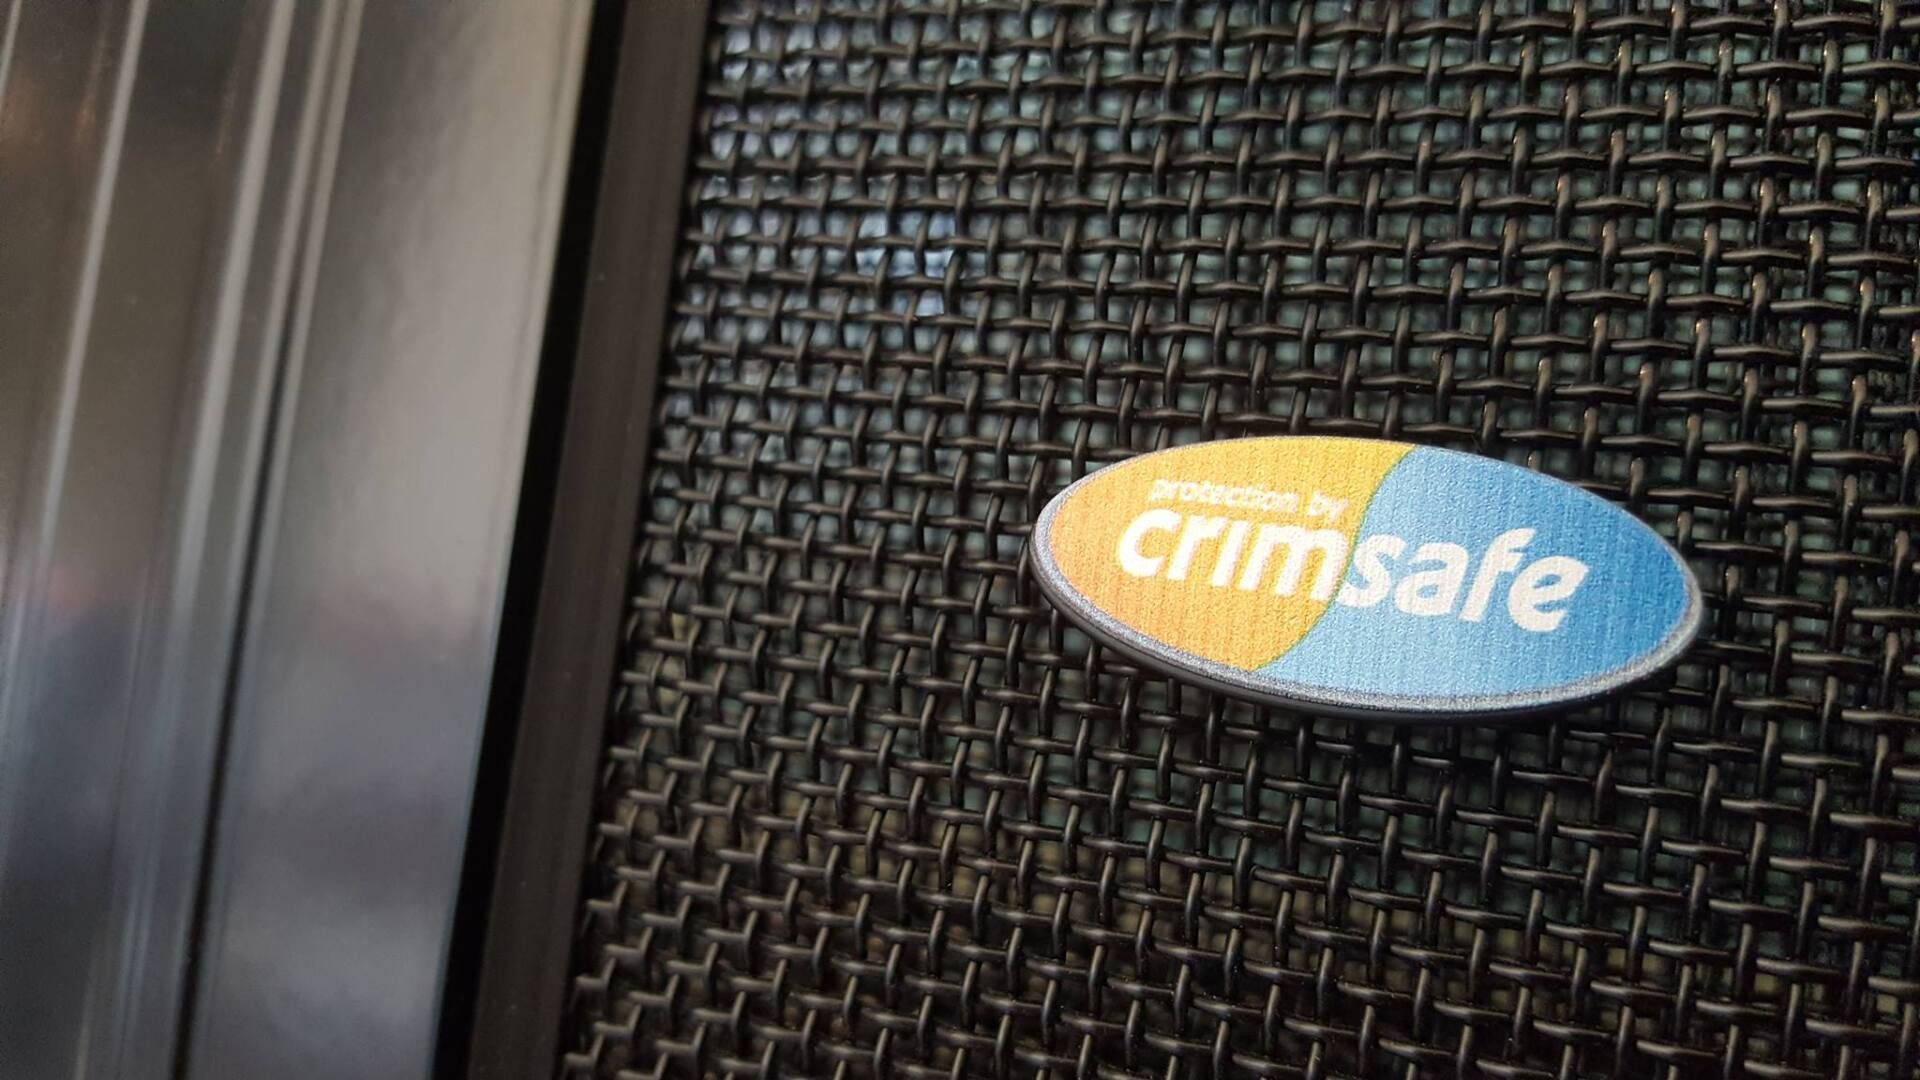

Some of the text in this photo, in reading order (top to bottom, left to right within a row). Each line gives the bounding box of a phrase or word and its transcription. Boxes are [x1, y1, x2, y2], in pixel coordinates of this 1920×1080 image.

[1150, 478, 1349, 523] protection by
[1117, 507, 1590, 633] crimsafe
